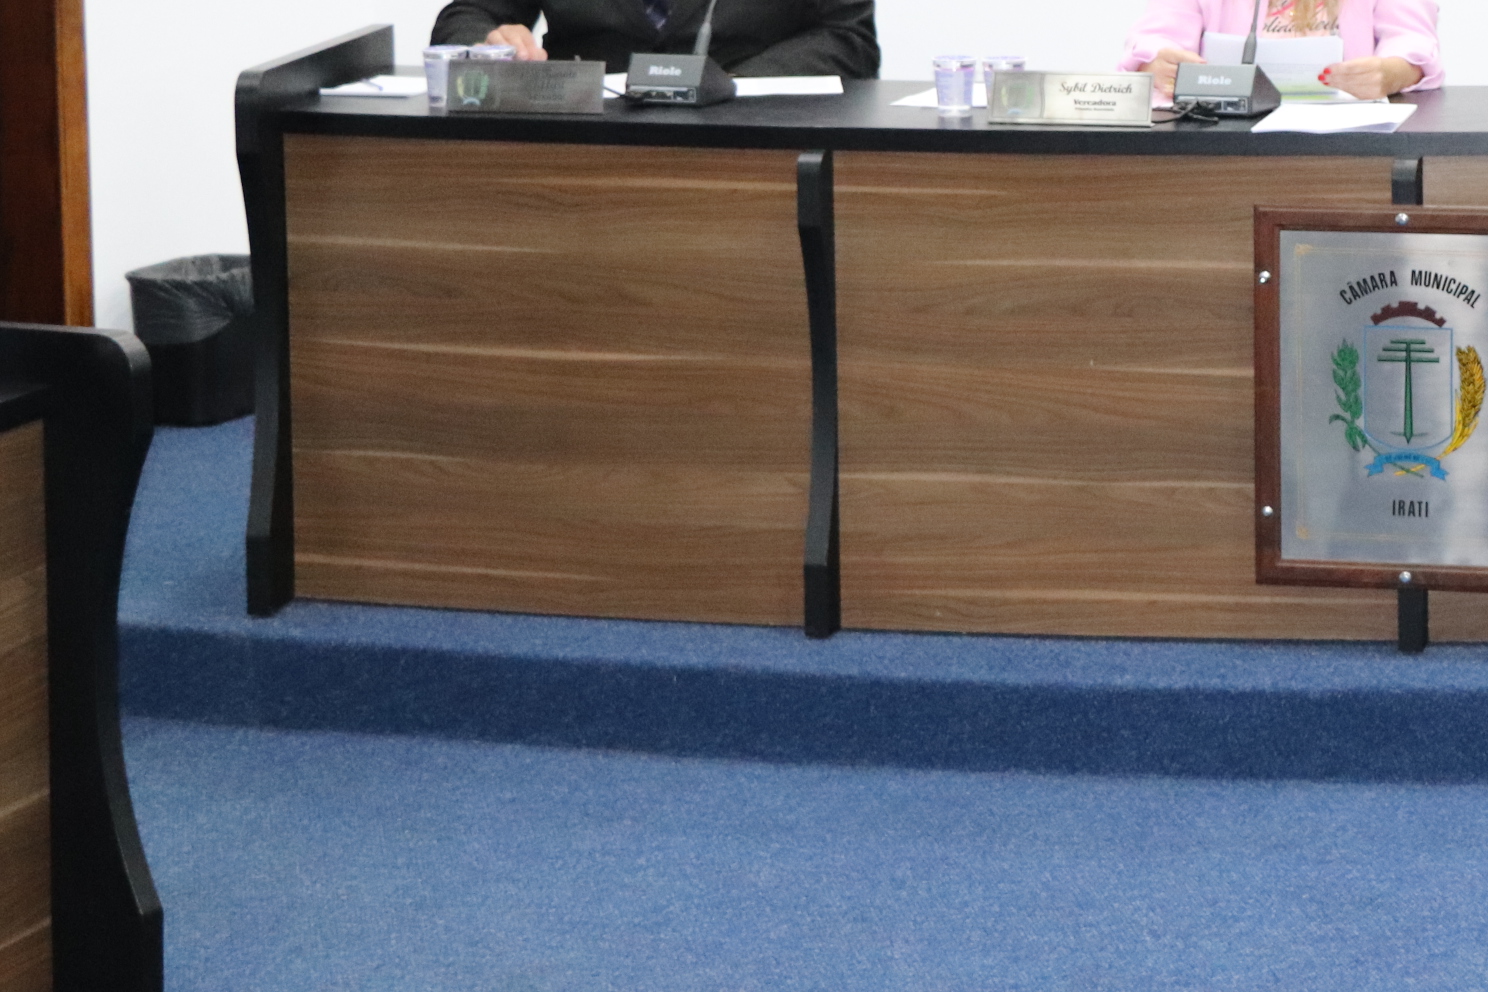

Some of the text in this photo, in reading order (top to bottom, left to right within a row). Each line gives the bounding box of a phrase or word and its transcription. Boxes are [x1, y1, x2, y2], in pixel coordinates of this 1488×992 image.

[648, 65, 682, 76] Riele
[1197, 74, 1232, 85] Riele
[1059, 81, 1088, 96] Sybil
[1073, 98, 1117, 107] Vereadora
[1339, 269, 1481, 309] CÂMARA MUNICIPAL
[1392, 499, 1429, 518] IRATI
